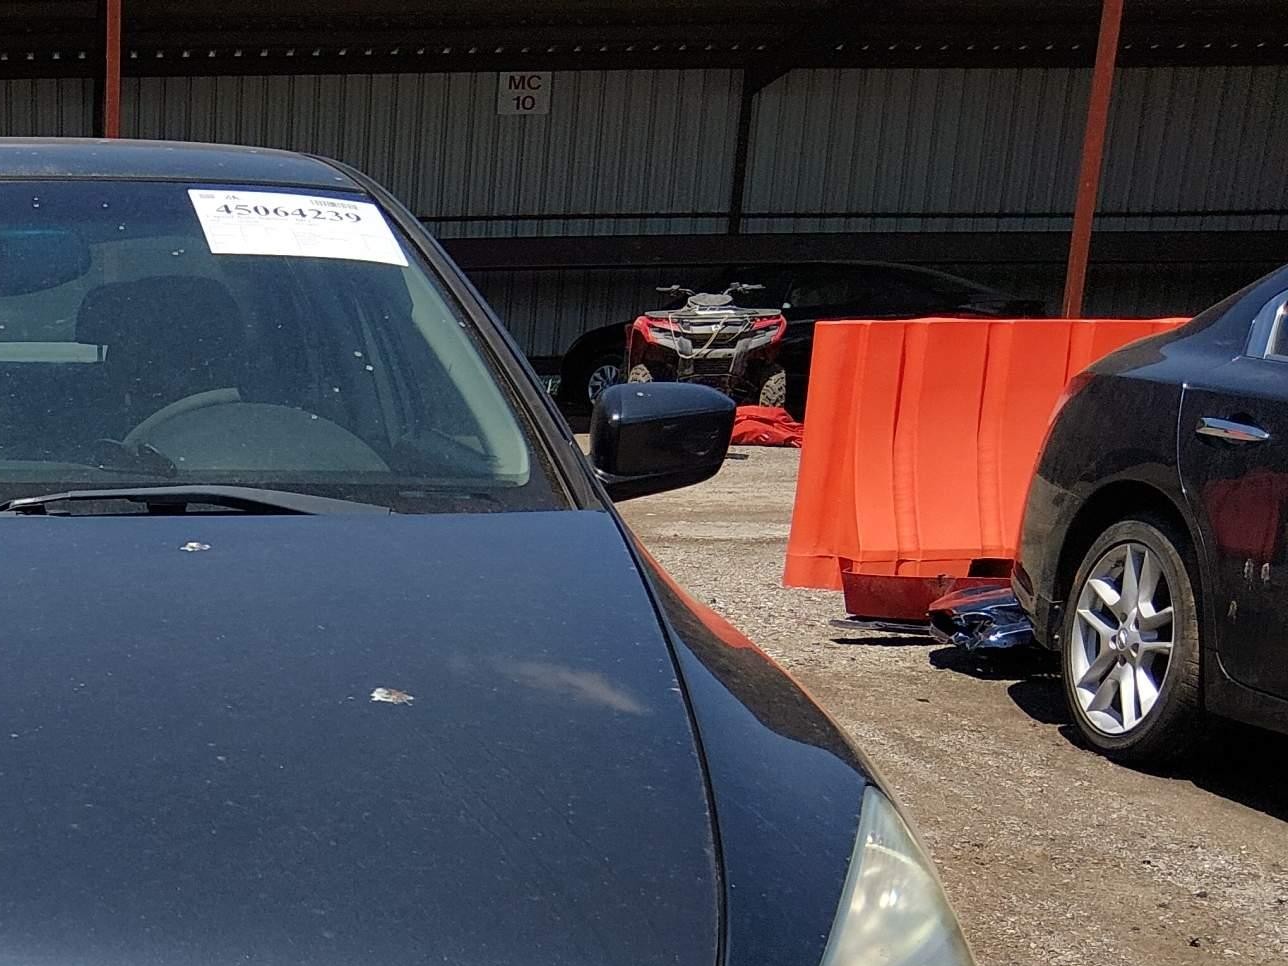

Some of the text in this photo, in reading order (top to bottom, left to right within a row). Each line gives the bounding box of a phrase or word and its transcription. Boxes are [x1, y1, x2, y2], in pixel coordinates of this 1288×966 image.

[508, 75, 541, 90] MC
[512, 95, 535, 110] 10
[215, 203, 362, 223] 45064239
